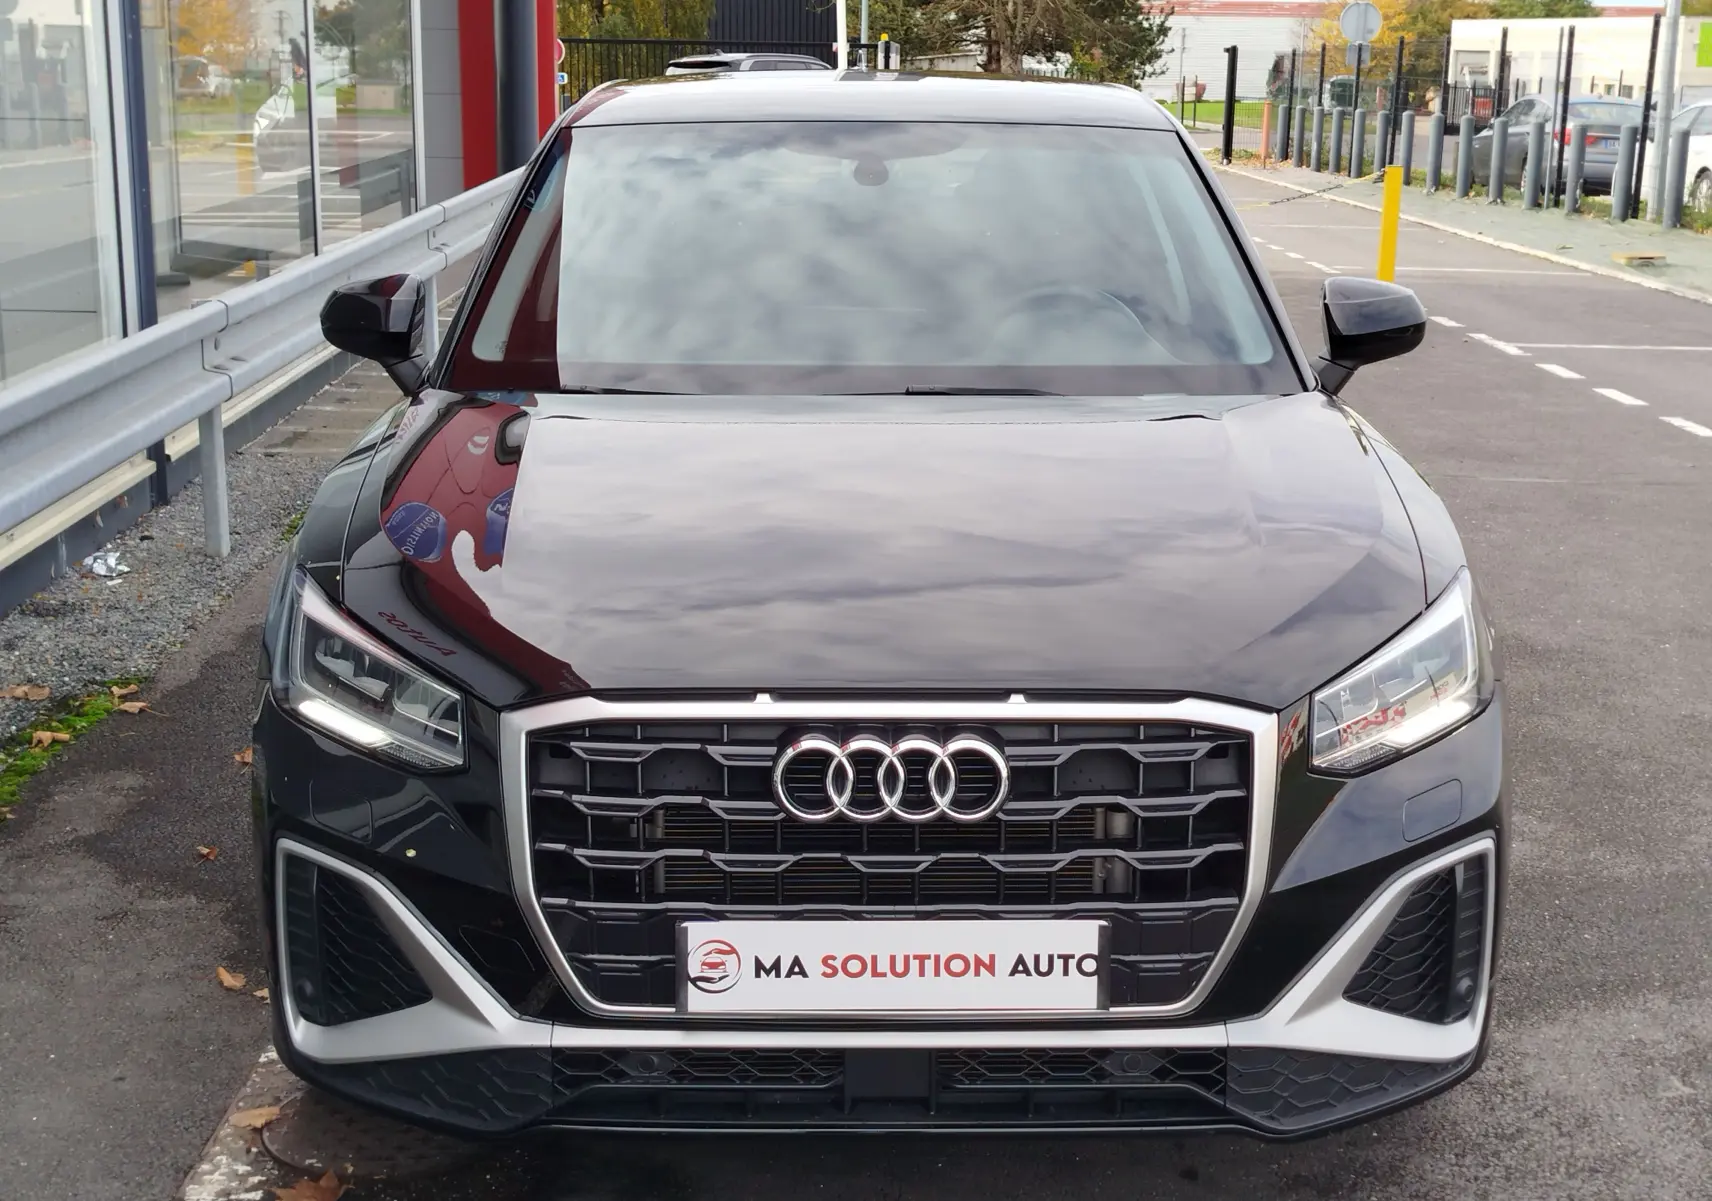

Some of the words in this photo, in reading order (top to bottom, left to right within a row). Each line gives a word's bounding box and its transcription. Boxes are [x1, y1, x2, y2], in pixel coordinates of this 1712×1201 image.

[754, 954, 809, 979] MA
[820, 952, 996, 978] SOLUTION
[1008, 952, 1099, 977] AUTO
